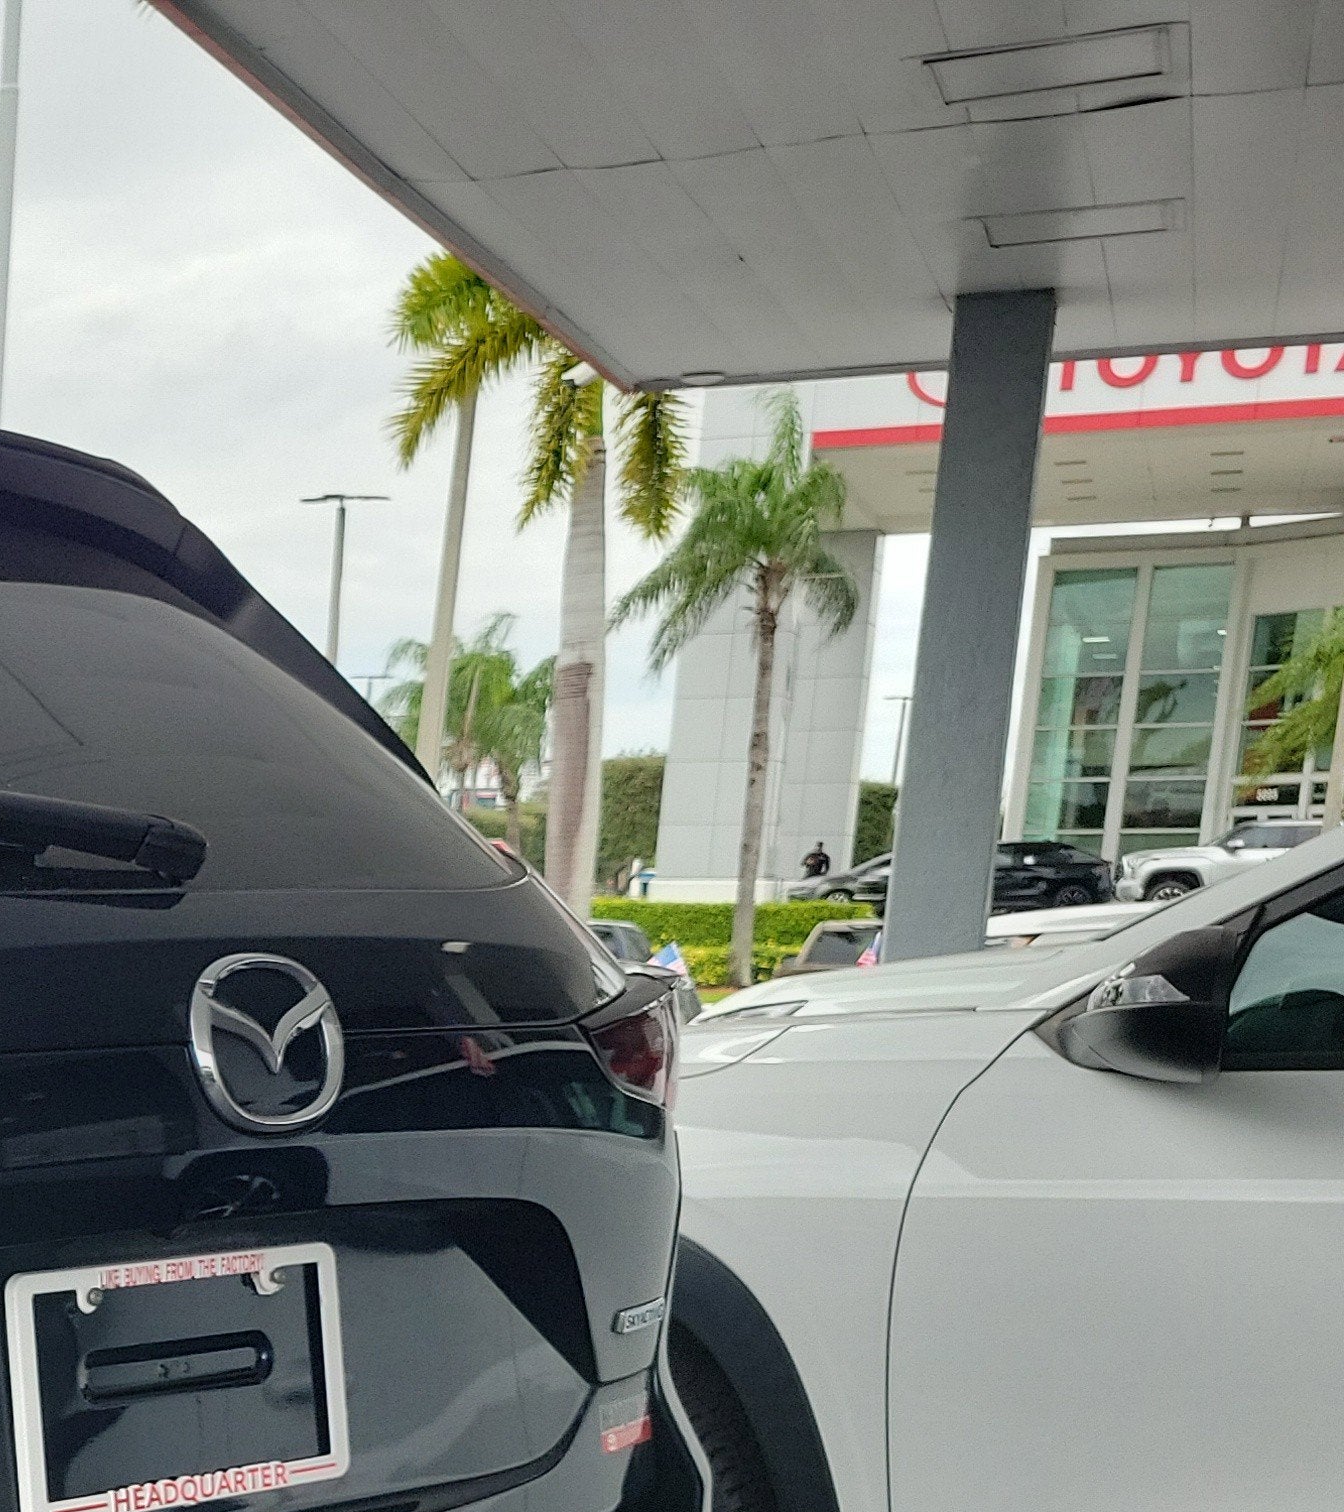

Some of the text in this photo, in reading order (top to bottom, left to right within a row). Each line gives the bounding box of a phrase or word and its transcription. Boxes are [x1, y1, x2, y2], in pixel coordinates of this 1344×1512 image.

[1060, 343, 1344, 391] TOYOT
[125, 1264, 161, 1287] BUYING
[166, 1260, 193, 1280] FROM
[199, 1258, 216, 1276] THE
